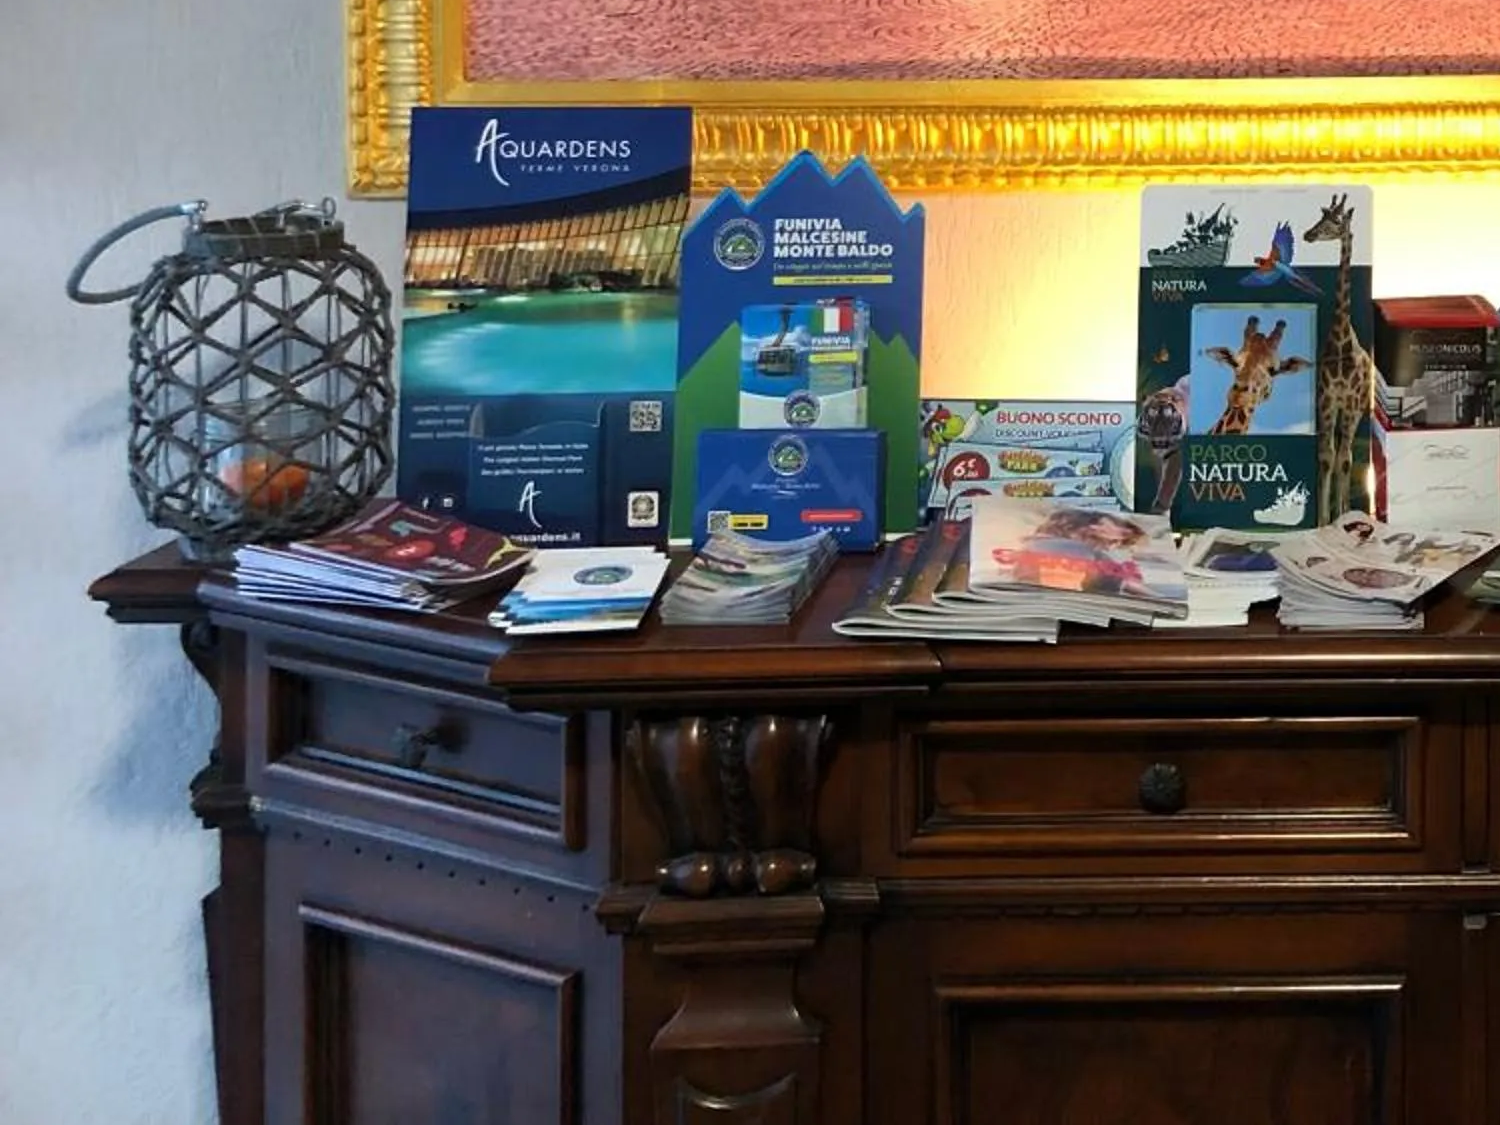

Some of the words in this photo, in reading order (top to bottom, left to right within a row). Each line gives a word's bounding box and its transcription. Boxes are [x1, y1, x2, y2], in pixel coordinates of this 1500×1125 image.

[475, 118, 632, 187] AQUARDENS
[521, 163, 564, 173] TERME
[573, 163, 631, 173] VERONA
[775, 218, 843, 231] FUNIVIA
[774, 230, 868, 245] MALCESINE
[773, 244, 836, 259] MONTE
[837, 244, 894, 257] BALDO
[1152, 279, 1208, 292] NATURA
[996, 411, 1055, 425] BUONO
[1057, 412, 1122, 426] SCONTO
[1190, 444, 1267, 462] PARCO
[1190, 462, 1288, 482] NATURA
[1188, 482, 1246, 501] VIVA
